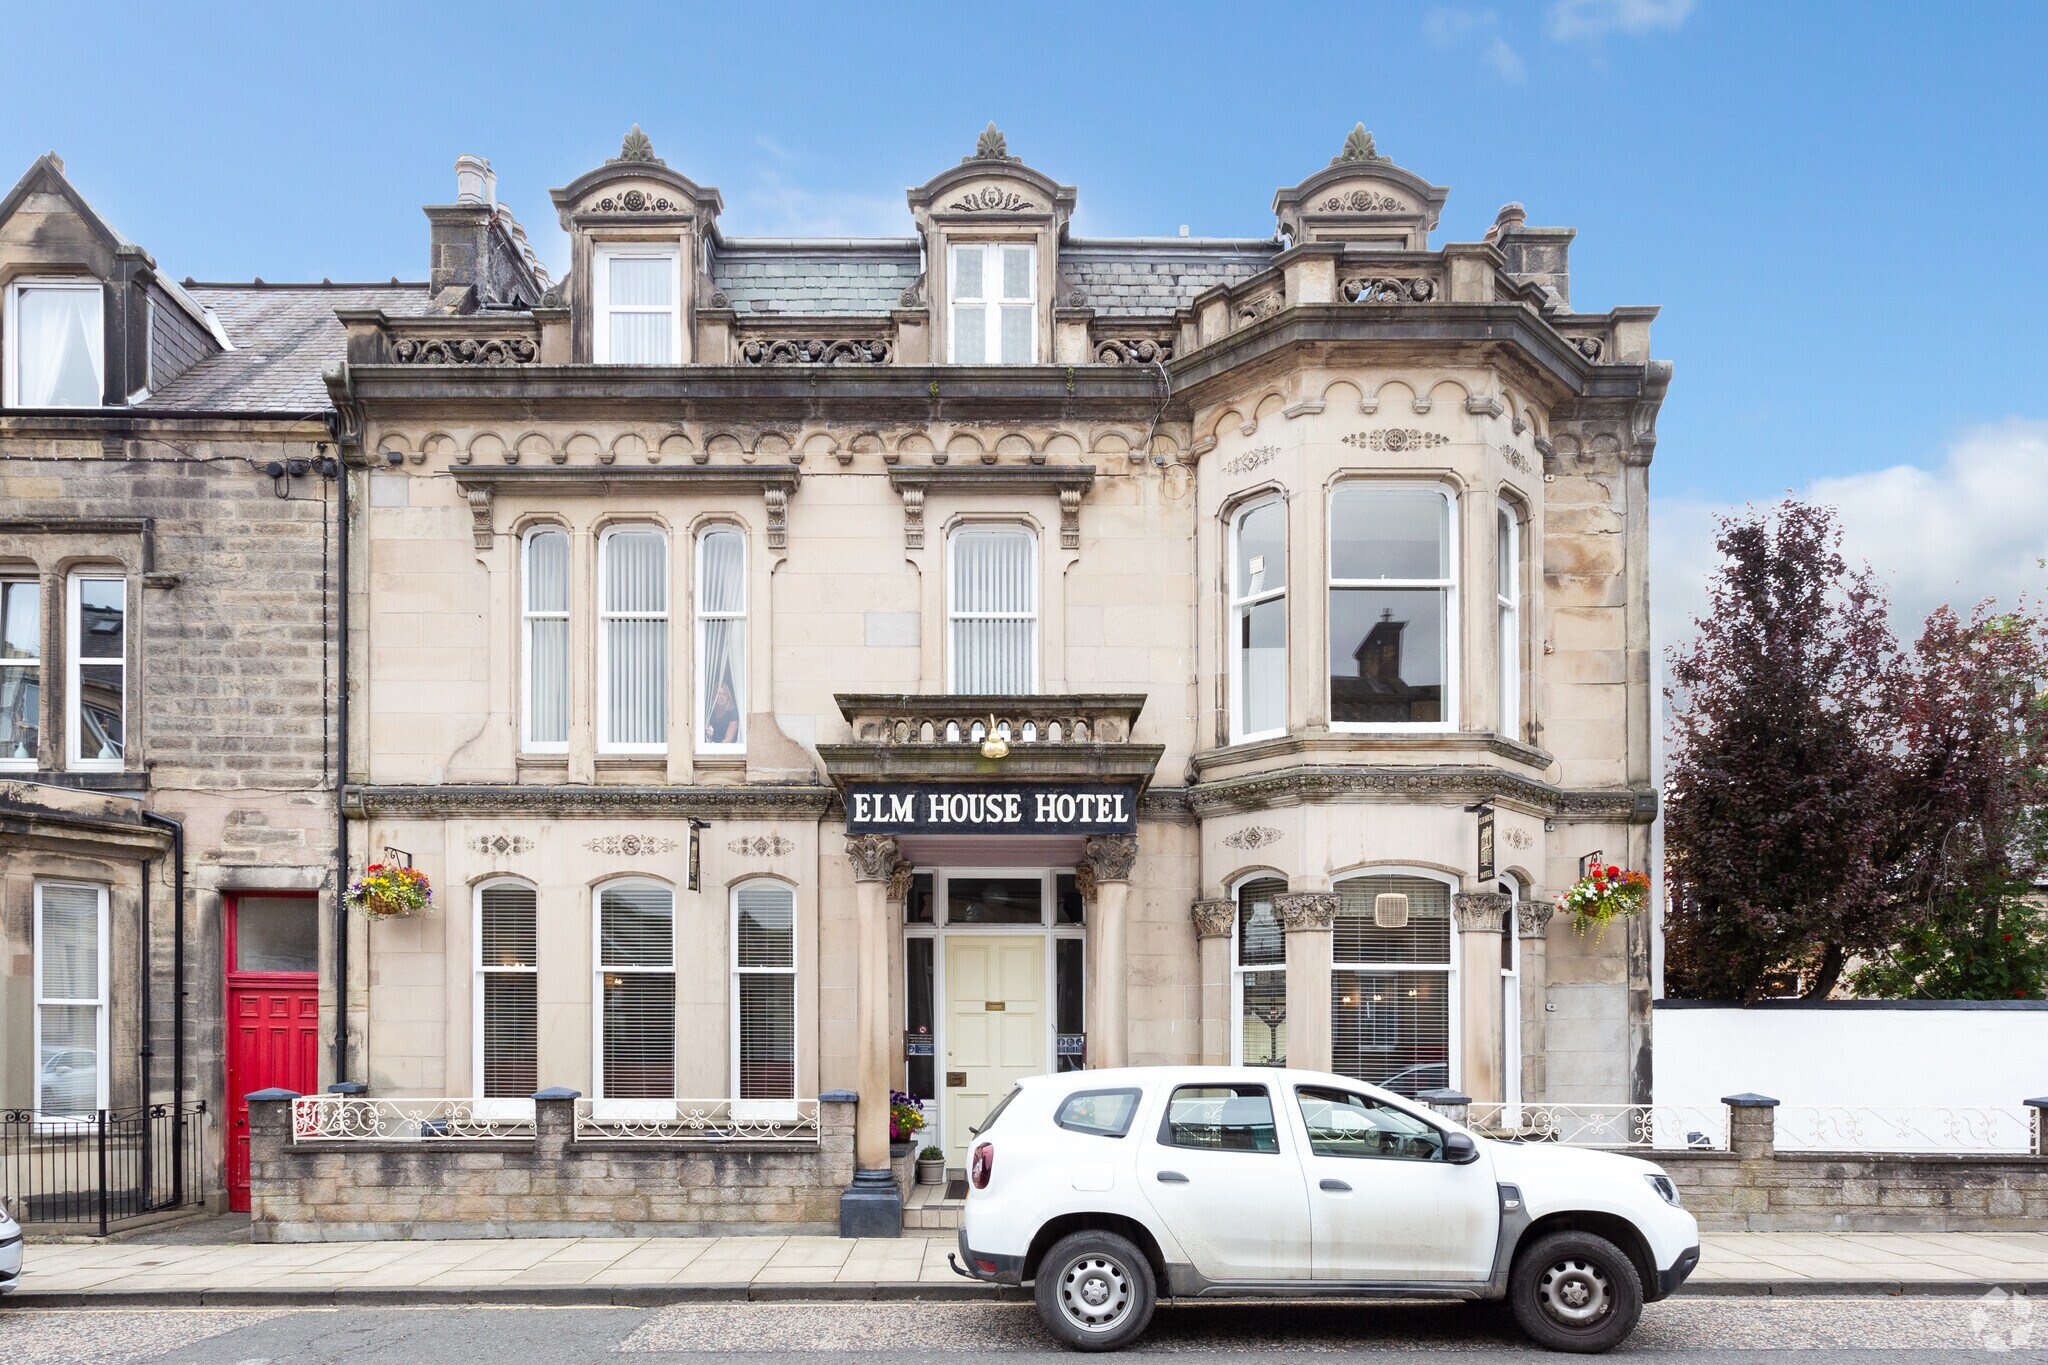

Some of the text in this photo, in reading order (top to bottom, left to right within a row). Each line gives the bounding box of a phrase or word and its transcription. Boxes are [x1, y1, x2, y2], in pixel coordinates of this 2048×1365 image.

[853, 793, 1129, 823] ELM HOUSE HOTEL
